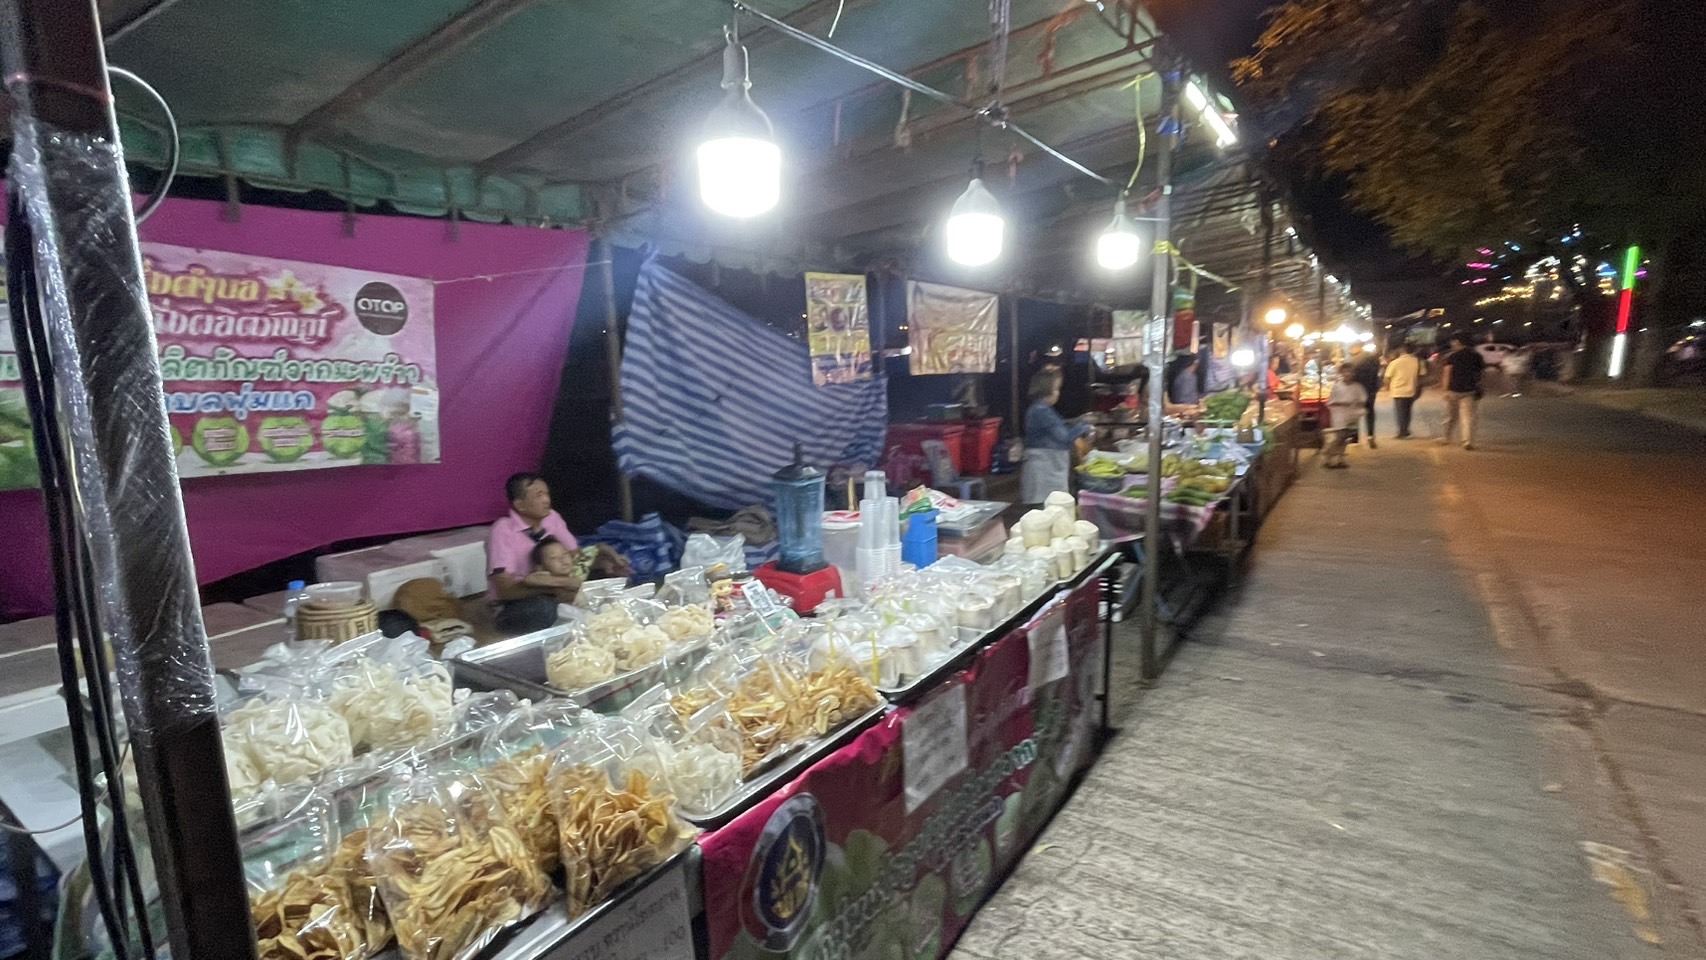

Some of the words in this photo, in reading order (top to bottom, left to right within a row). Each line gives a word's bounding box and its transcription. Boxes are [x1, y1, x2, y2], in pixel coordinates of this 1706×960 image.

[358, 298, 404, 313] OTOP
[160, 345, 419, 383] ลิตภัณฑ์จากมะพร้าว
